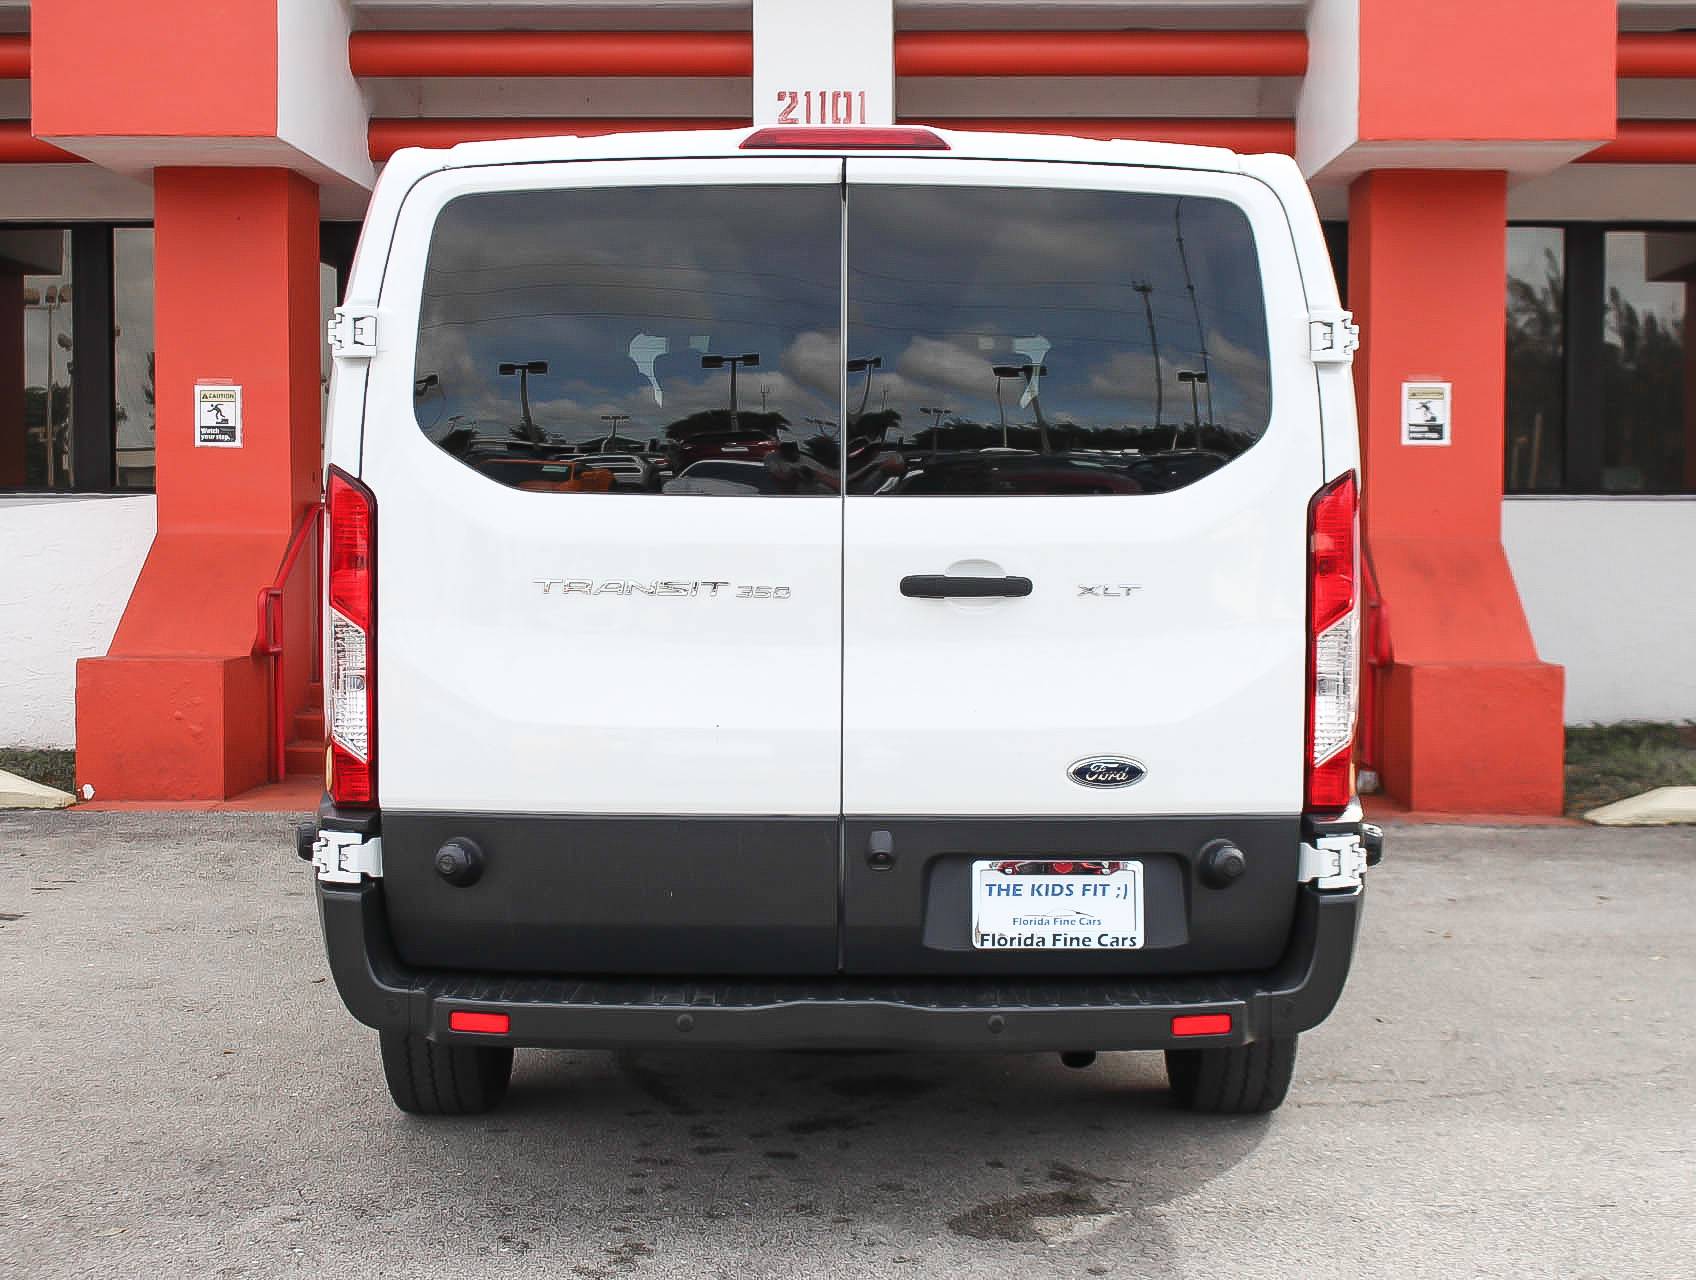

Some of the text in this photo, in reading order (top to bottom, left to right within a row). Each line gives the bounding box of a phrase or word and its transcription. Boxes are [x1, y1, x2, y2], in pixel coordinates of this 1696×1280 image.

[777, 91, 866, 124] 21101
[533, 579, 730, 596] TRANSIT
[1076, 583, 1143, 598] XLT
[1086, 762, 1129, 781] Ford
[985, 883, 1024, 897] THE
[1030, 883, 1075, 897] KIDS
[1081, 883, 1111, 897] FIT
[1012, 917, 1102, 926] Florida Fine Cars
[980, 933, 1137, 947] Florida Fine Cars
